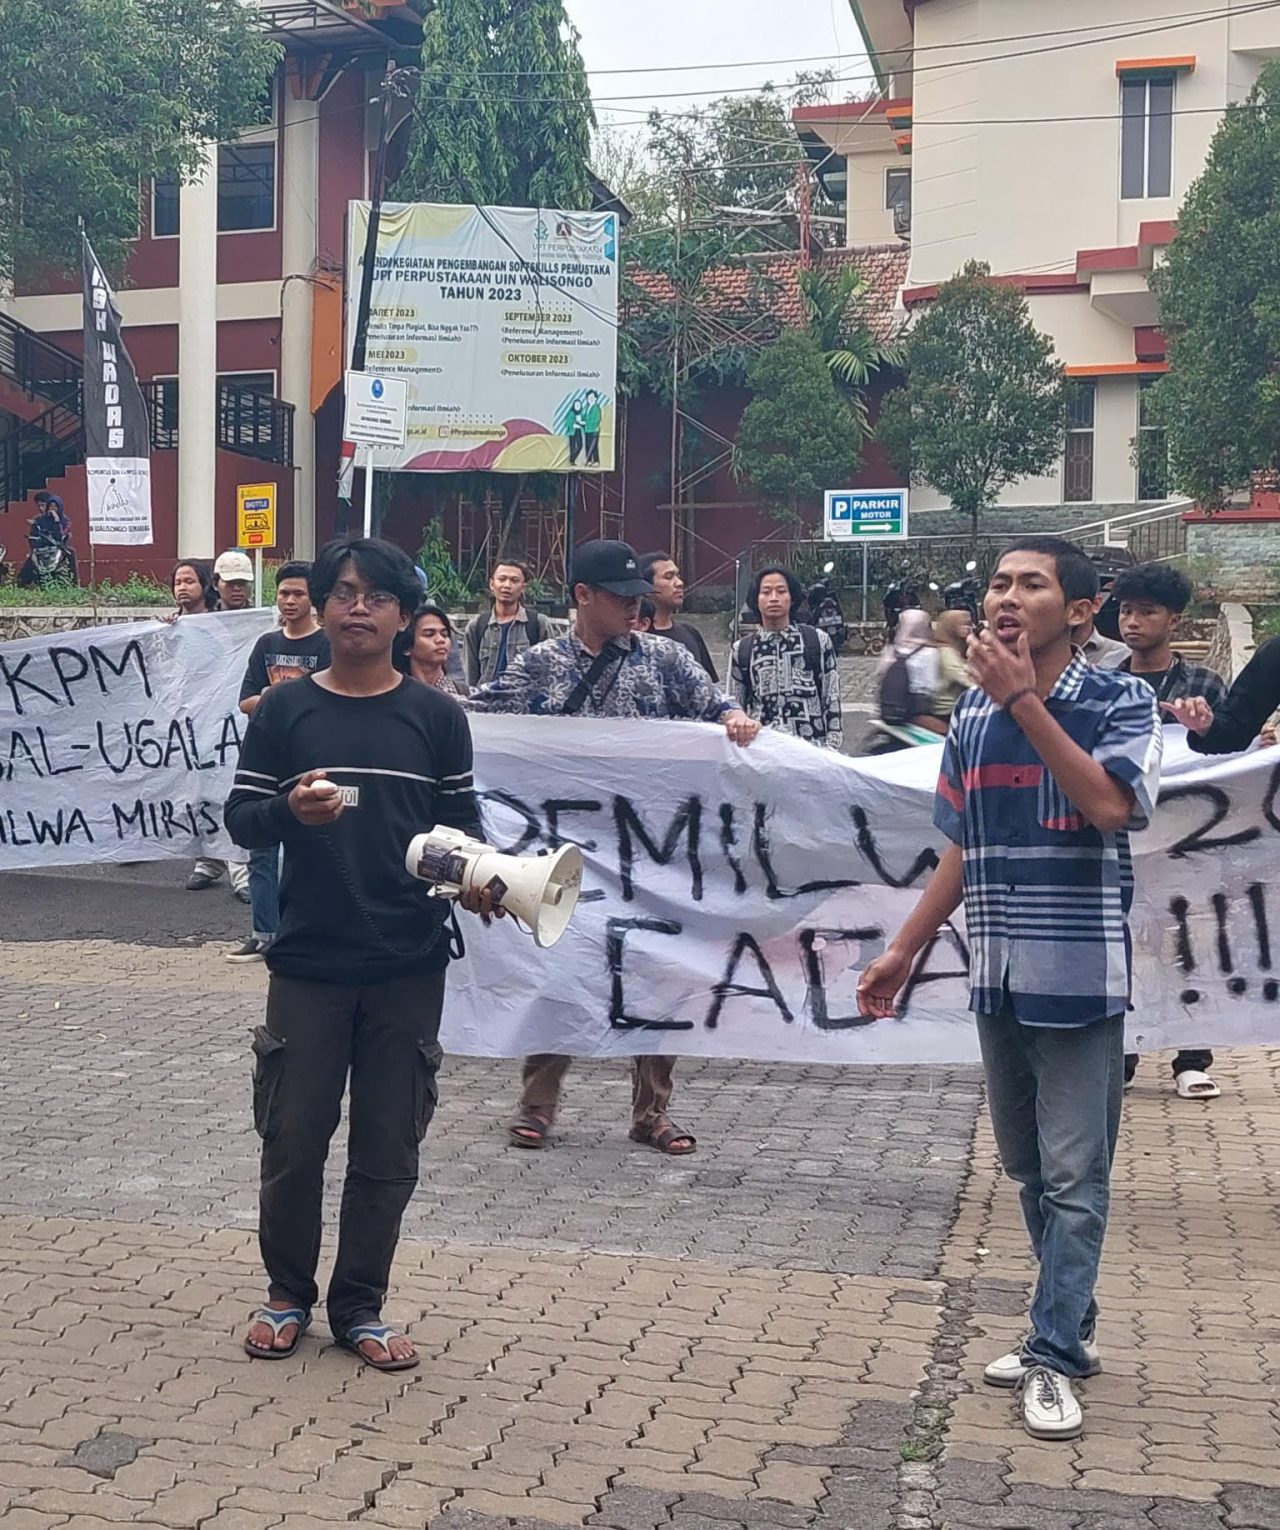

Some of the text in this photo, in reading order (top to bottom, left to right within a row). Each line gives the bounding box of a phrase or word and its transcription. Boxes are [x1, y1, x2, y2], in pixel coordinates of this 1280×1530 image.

[436, 257, 507, 272] PENGEMBANGAN
[561, 262, 611, 276] PEMUSTAKA
[396, 270, 491, 284] PERPUSTAKAAN
[495, 273, 517, 286] UIN
[520, 274, 593, 288] WALISONGO
[440, 286, 522, 301] TAHUN 2023
[395, 308, 415, 318] 2023
[504, 312, 572, 323] SEPTEMBER 2023
[368, 350, 405, 359] MEI 2023
[508, 353, 569, 364] OKTOBER 2023
[102, 340, 125, 449] WADAS
[834, 500, 848, 518] P
[853, 499, 899, 510] PARKIR
[860, 511, 892, 519] MOTOR
[111, 799, 220, 840] MIRIS
